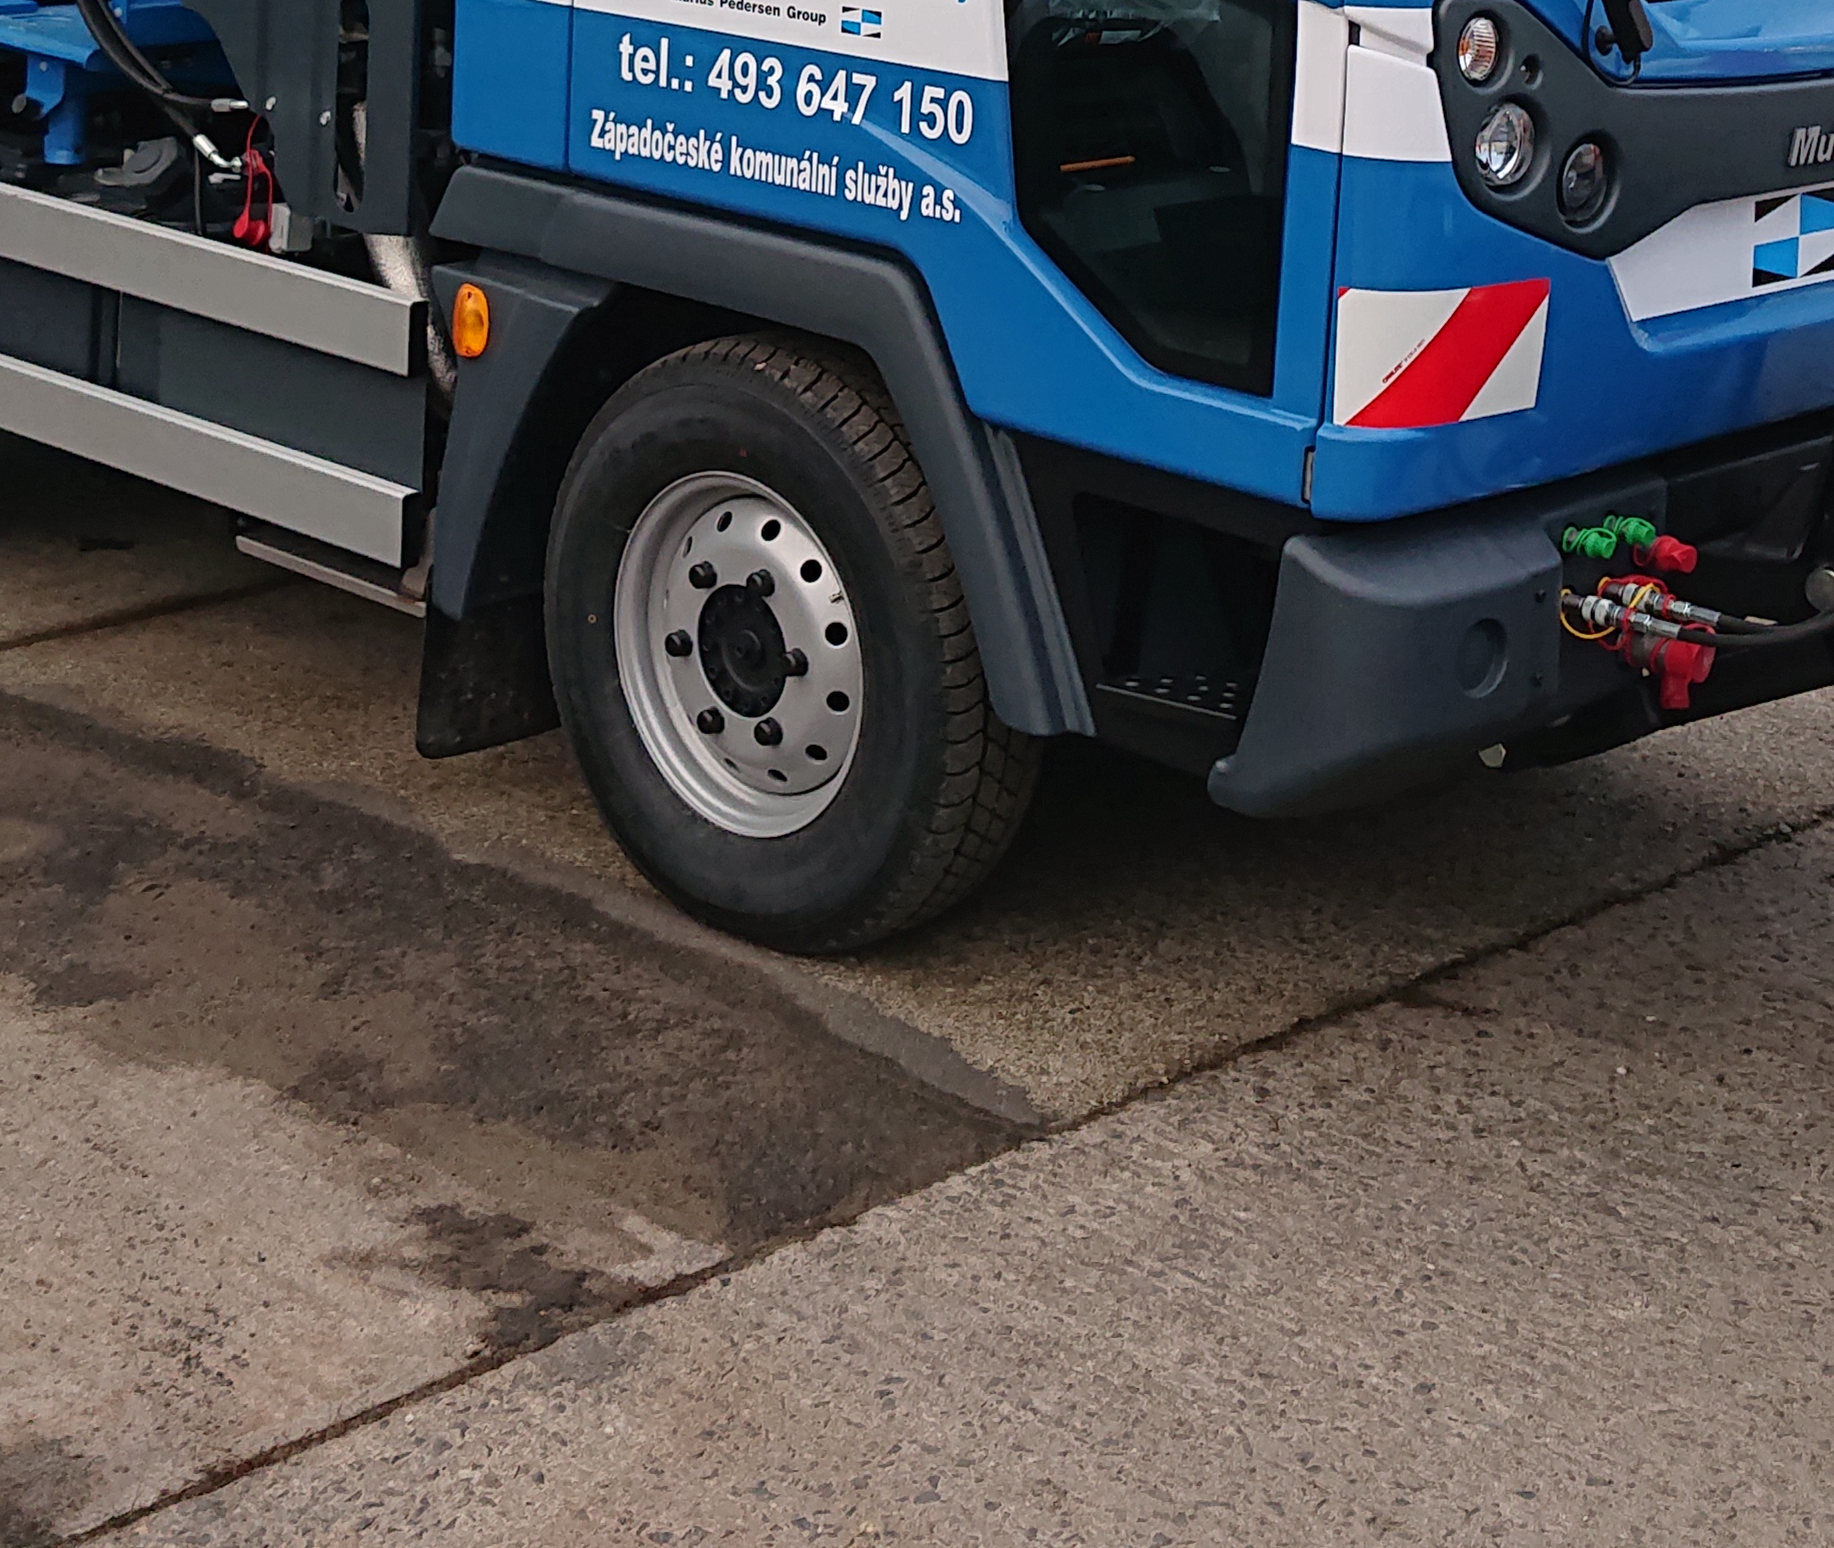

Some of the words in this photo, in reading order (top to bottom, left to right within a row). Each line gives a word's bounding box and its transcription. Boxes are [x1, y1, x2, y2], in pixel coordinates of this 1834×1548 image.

[786, 5, 827, 26] Group
[618, 32, 694, 93] tel.:
[707, 48, 783, 109] 493
[795, 63, 878, 126] 647
[892, 80, 974, 145] 150
[590, 108, 723, 173] Západočeské
[729, 135, 840, 197] komunální
[844, 160, 914, 221] služby
[920, 184, 961, 224] a.s.
